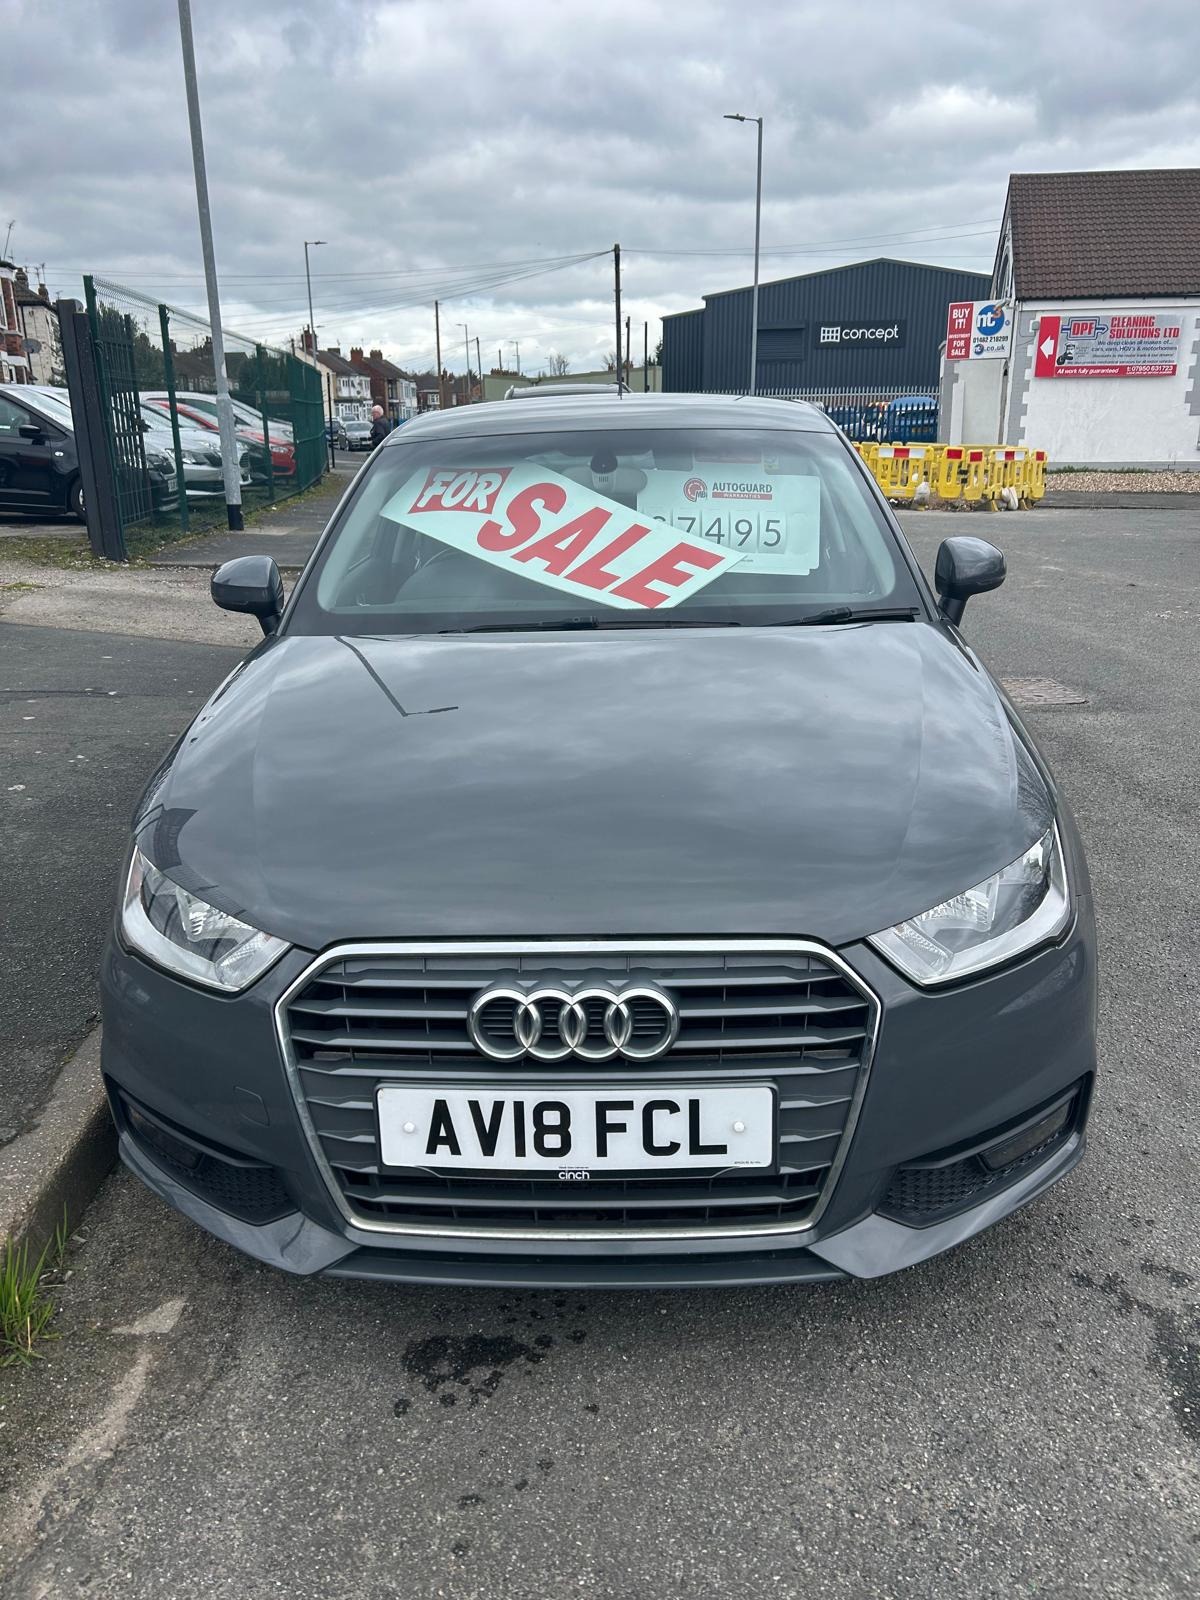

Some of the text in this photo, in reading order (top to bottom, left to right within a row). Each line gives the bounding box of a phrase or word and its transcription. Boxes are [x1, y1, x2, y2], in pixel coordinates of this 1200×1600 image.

[952, 308, 970, 318] BUY
[955, 319, 966, 329] IT!
[1110, 316, 1156, 328] CLEANING
[842, 324, 899, 342] concept
[1071, 322, 1095, 336] DPF
[1109, 327, 1180, 338] SOLUTIONS LTD
[712, 482, 773, 493] AUTOGUARD
[652, 515, 782, 547] 7495
[417, 470, 726, 609] FOR SALE
[425, 1098, 728, 1158] AV18 FCL
[558, 1170, 590, 1180] cinch
